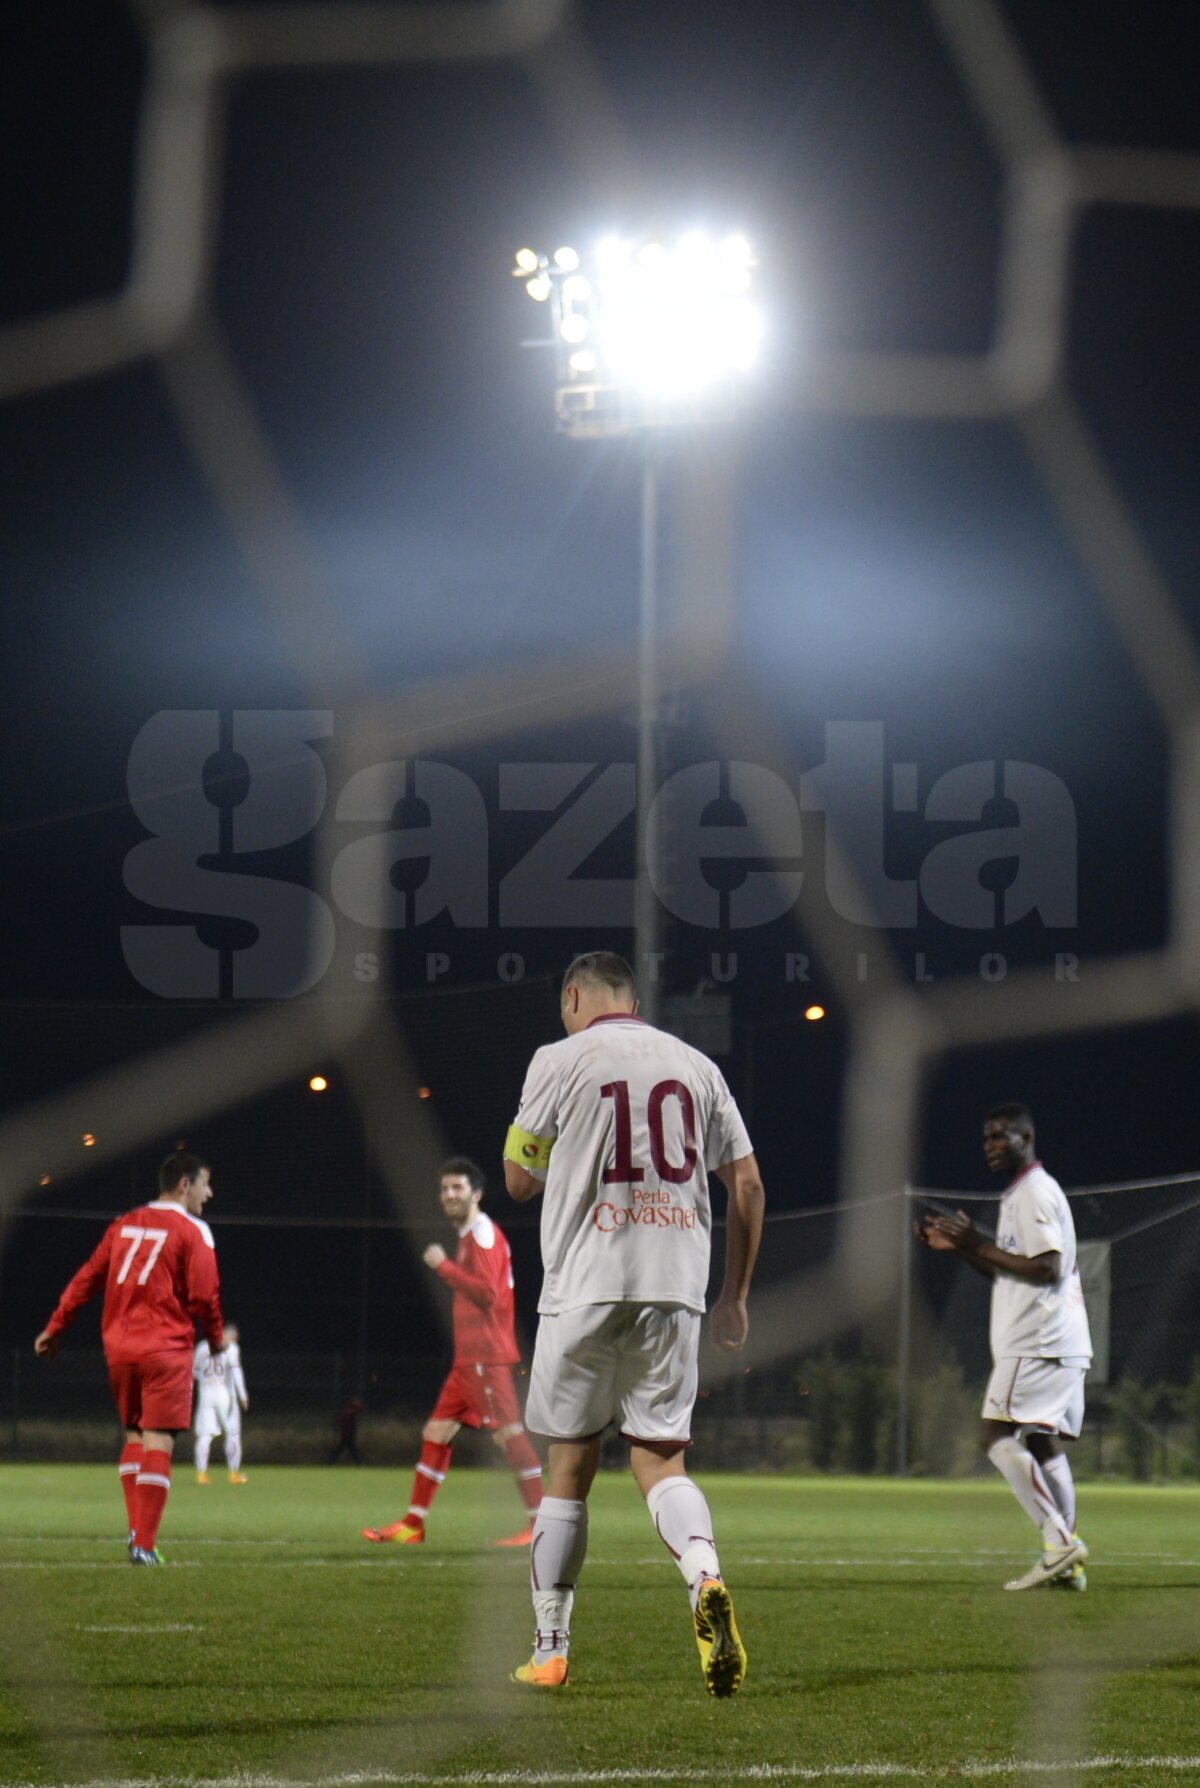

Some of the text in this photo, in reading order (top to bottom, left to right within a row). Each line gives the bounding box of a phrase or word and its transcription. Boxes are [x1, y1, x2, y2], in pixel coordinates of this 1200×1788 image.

[600, 1079, 697, 1184] 10
[632, 1189, 671, 1204] Perla
[116, 1225, 168, 1285] 77
